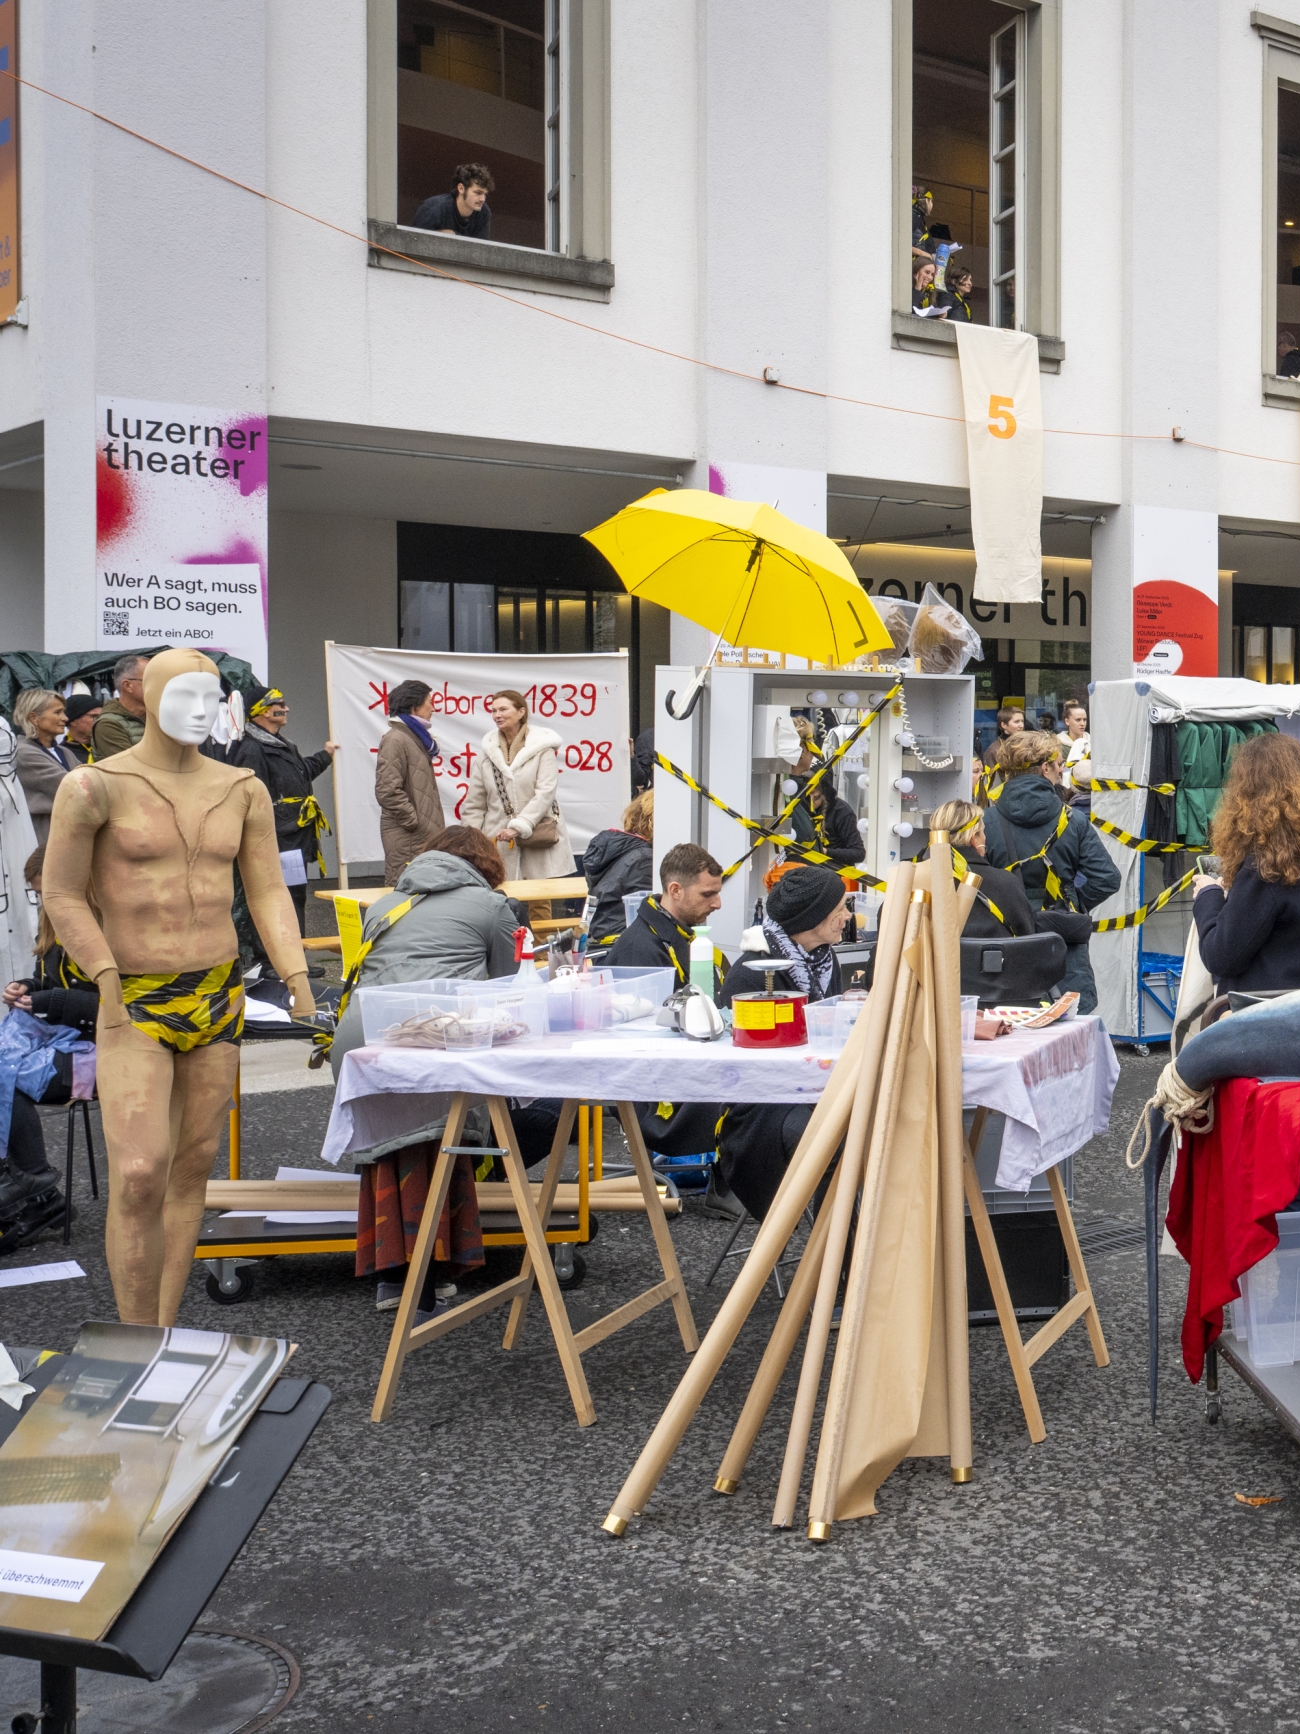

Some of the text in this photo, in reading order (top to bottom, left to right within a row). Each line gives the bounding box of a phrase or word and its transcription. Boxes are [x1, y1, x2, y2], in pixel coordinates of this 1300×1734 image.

[106, 408, 262, 451] luzerner
[987, 394, 1017, 440] 5
[103, 442, 245, 479] theater
[104, 572, 258, 594] Wer A sagt, muss
[104, 595, 243, 616] auch BO sagen.
[135, 627, 214, 640] Jetzt ein ABO!
[521, 682, 597, 718] 1839
[556, 739, 613, 773] 028
[2, 1569, 85, 1590] überschwemmt
